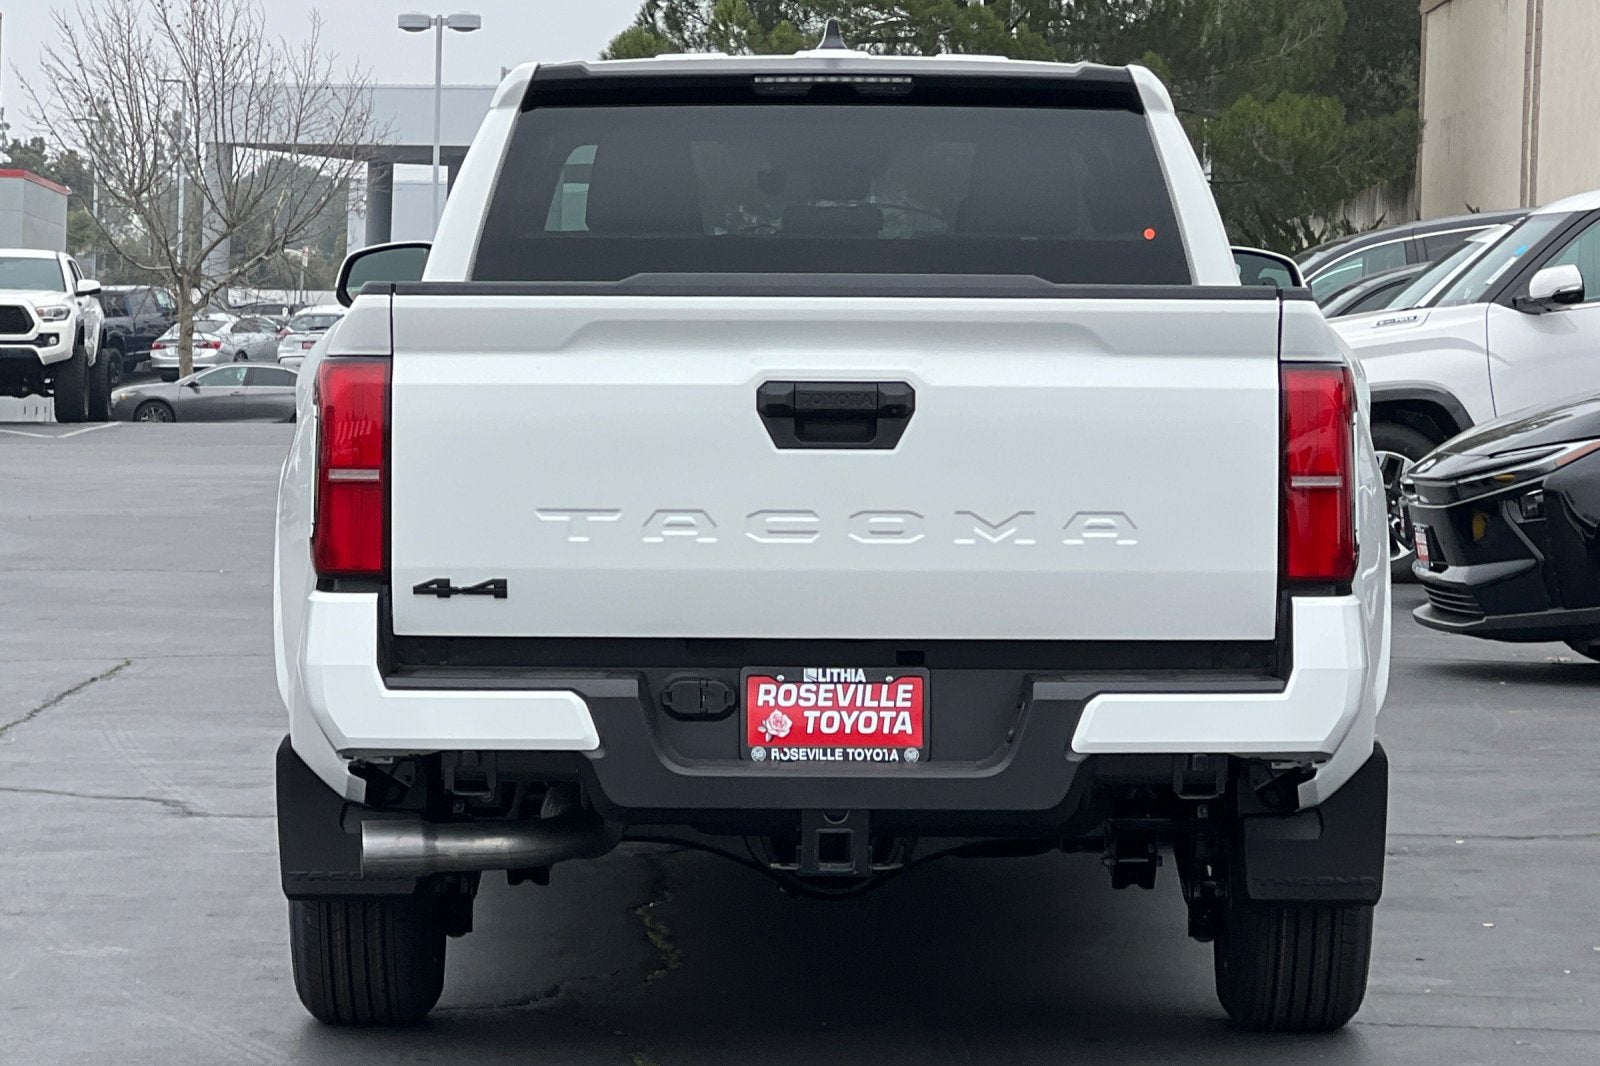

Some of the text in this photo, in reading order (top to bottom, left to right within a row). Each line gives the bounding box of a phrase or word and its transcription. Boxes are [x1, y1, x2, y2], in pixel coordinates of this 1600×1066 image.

[799, 391, 874, 407] TOYOTA
[536, 508, 1138, 544] TACOMA
[816, 668, 866, 682] LITHIA
[757, 684, 913, 707] ROSEVILLE
[803, 710, 913, 734] TOYOTA
[771, 748, 899, 761] ROSEVILLE TOYOTA
